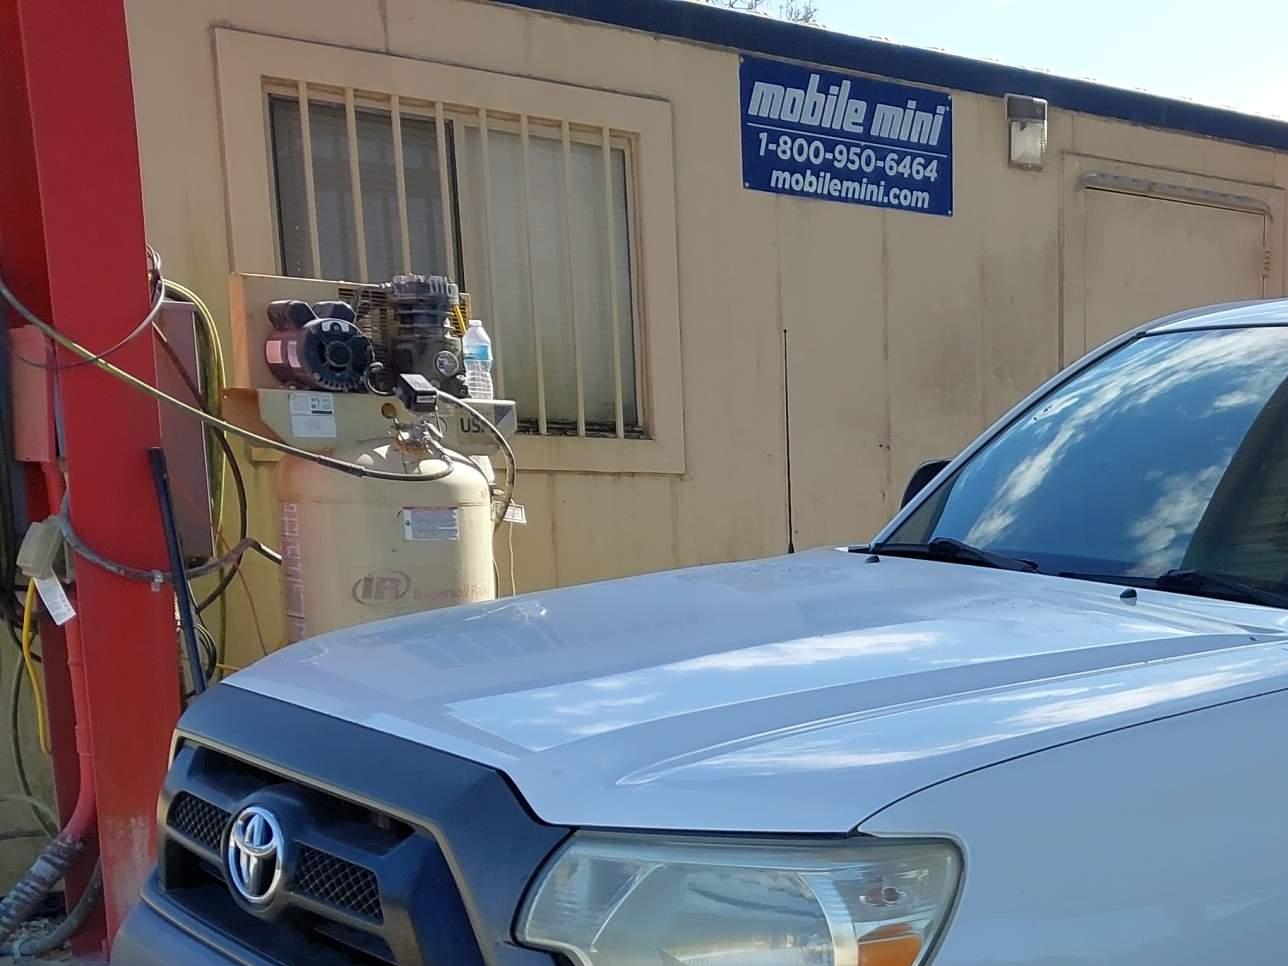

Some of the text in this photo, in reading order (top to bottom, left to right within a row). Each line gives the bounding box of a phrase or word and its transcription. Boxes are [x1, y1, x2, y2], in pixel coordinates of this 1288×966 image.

[747, 73, 946, 146] mobile mini
[758, 132, 938, 182] 1-800-950-6464
[770, 169, 930, 209] mobilemini.com
